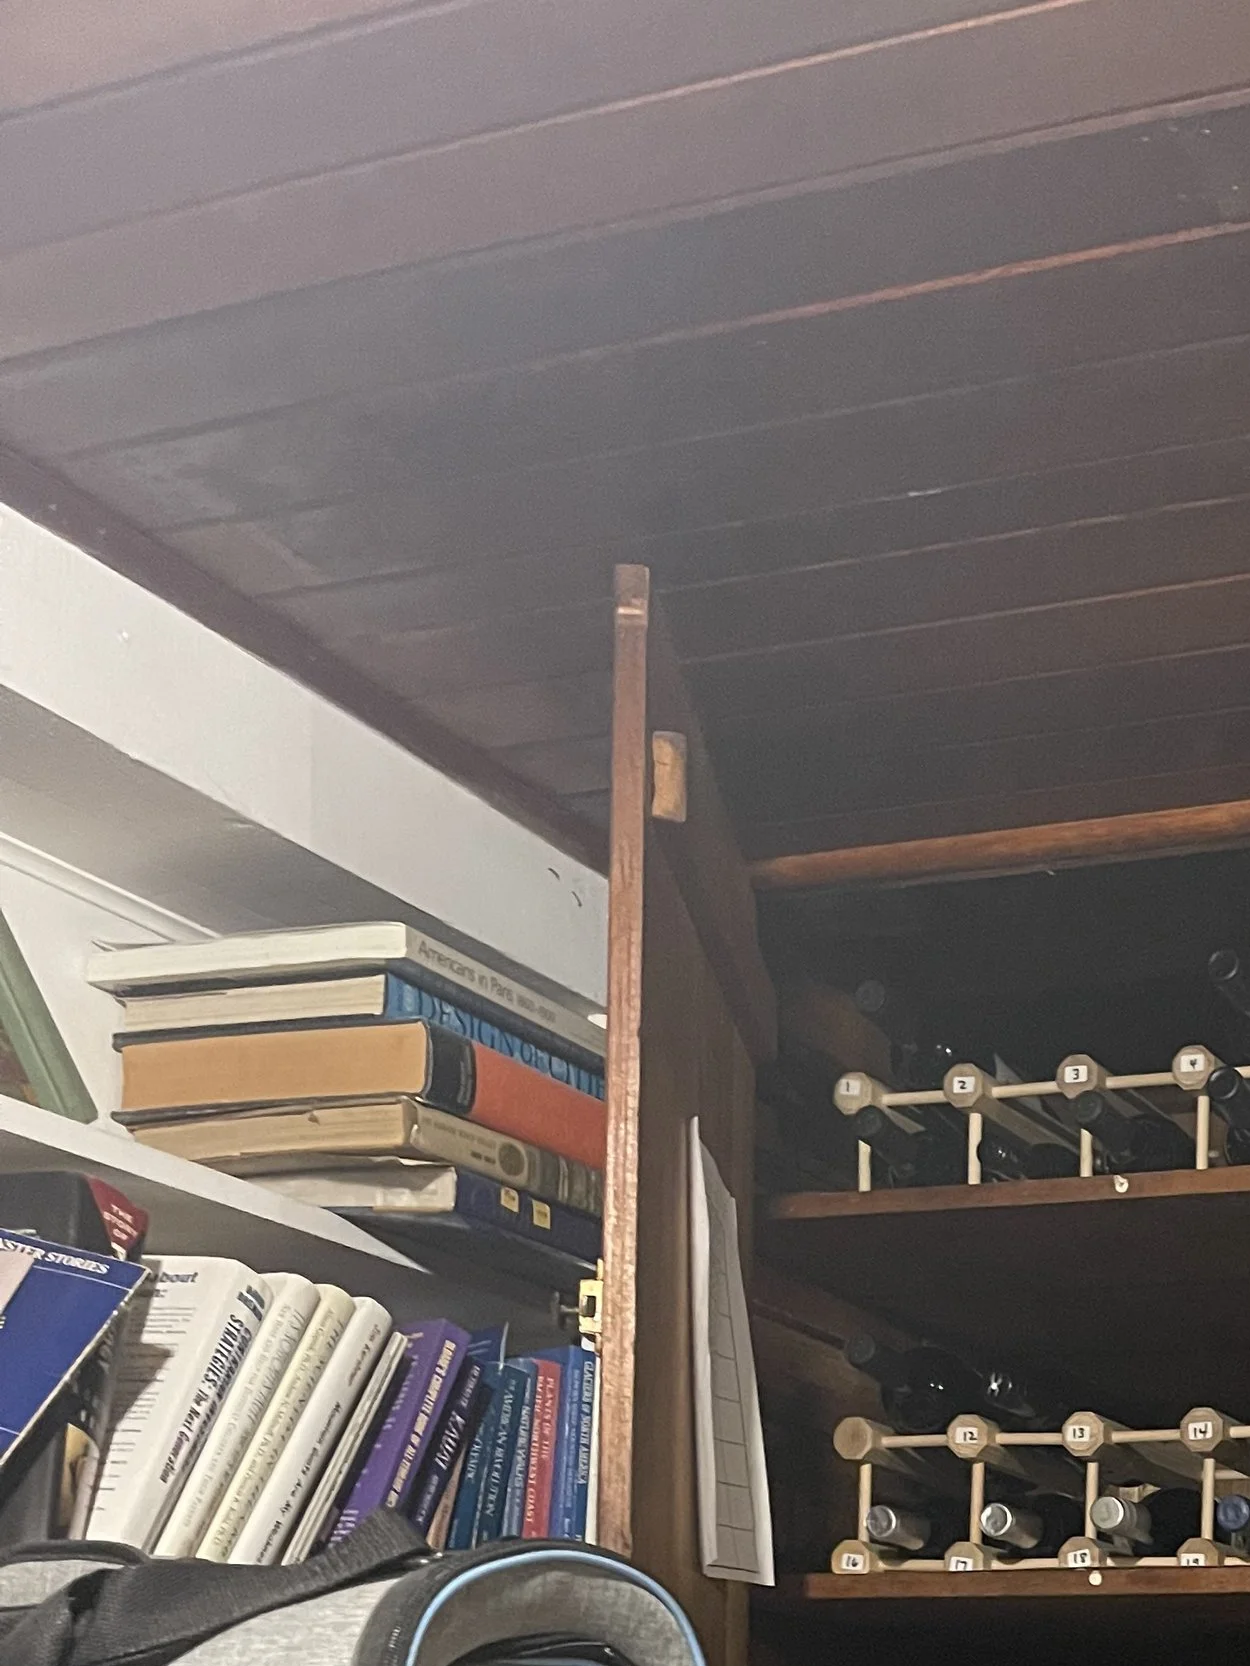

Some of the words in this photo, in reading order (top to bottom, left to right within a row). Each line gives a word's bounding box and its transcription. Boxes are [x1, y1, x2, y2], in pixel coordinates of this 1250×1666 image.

[1189, 1058, 1198, 1070] 4
[1072, 1068, 1081, 1080] 3
[845, 1081, 851, 1093] 1
[957, 1080, 967, 1090] 2
[45, 1252, 109, 1275] STORIES
[200, 1314, 248, 1385] STRATEGIES:
[581, 1360, 594, 1402] GLACIERS
[190, 1388, 210, 1406] The
[180, 1406, 203, 1430] Next
[579, 1414, 591, 1444] NORTH
[962, 1431, 978, 1442] 12
[1072, 1427, 1085, 1439] 13
[1193, 1423, 1208, 1439] 14
[431, 1409, 466, 1471] KAUAI
[157, 1430, 192, 1484] Generation
[577, 1444, 588, 1484] AMERICA
[524, 1486, 537, 1524] COAST
[845, 1555, 859, 1568] 16
[1073, 1552, 1087, 1564] 18
